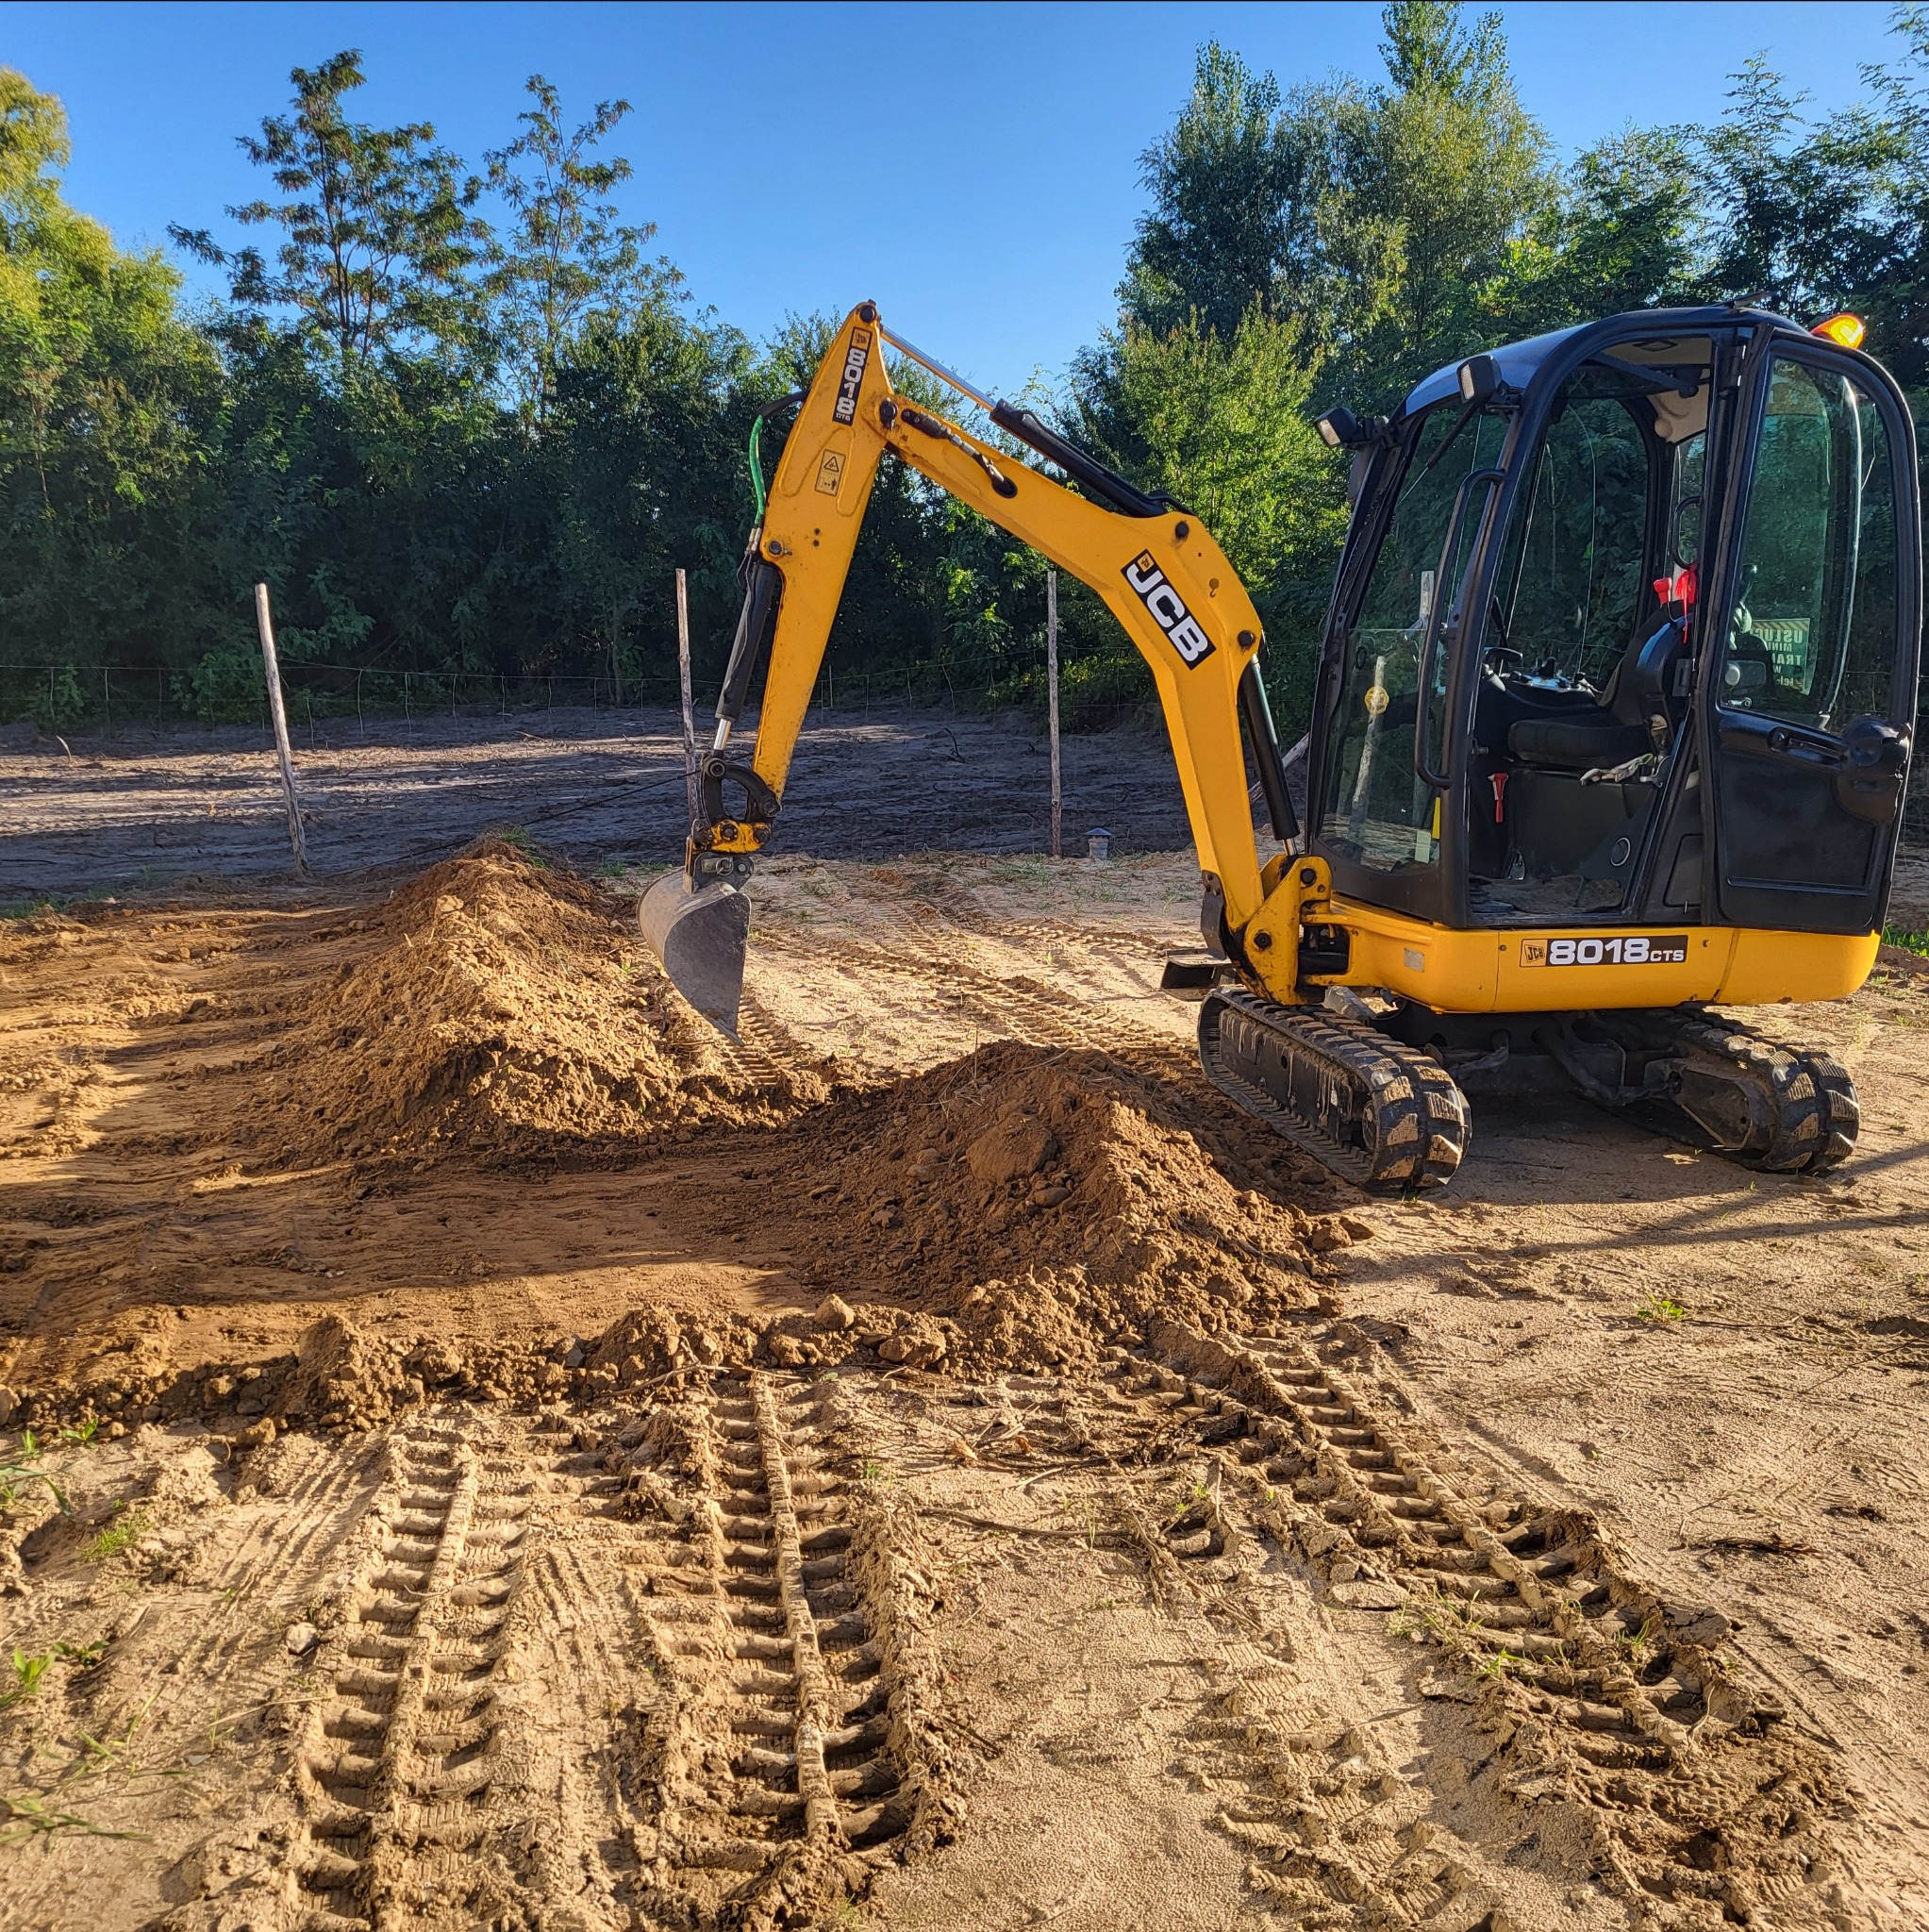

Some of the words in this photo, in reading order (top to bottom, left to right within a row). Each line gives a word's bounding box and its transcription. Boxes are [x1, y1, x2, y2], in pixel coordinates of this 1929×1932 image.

[837, 348, 866, 415] 8018
[1126, 563, 1208, 662] JCB
[1527, 946, 1544, 961] JCB
[1549, 938, 1650, 965] 8018
[1651, 949, 1685, 962] CTS
